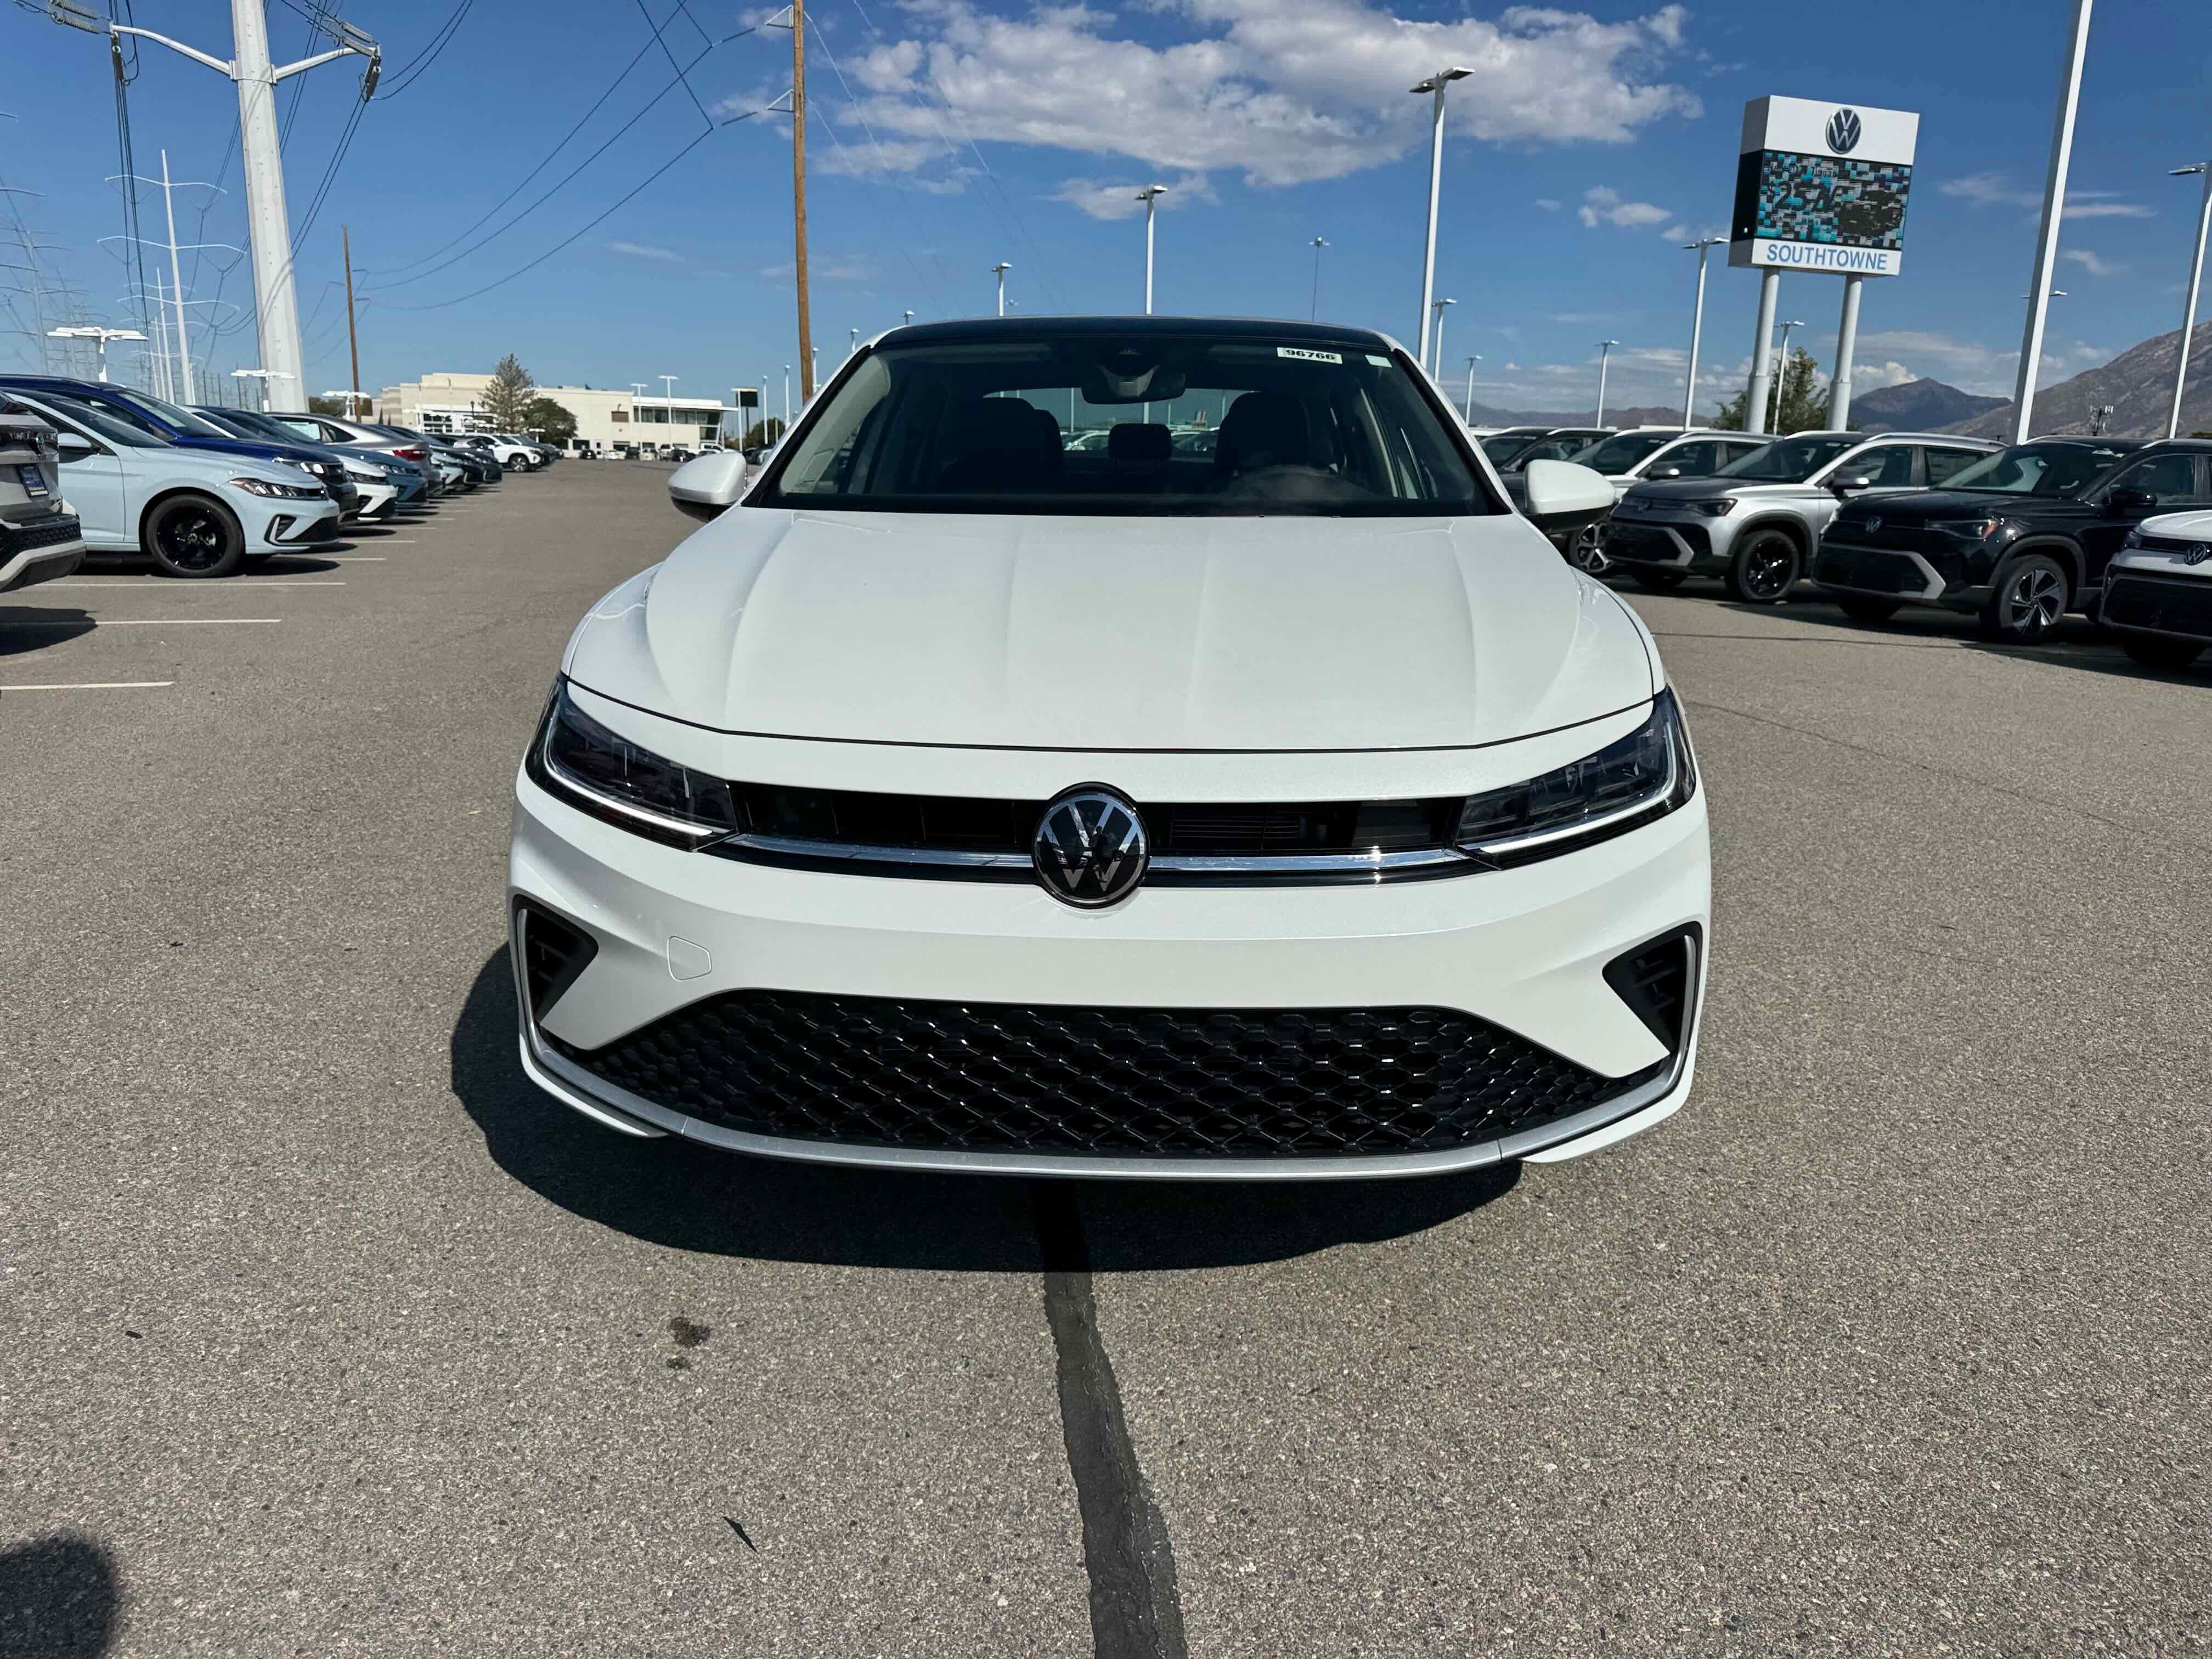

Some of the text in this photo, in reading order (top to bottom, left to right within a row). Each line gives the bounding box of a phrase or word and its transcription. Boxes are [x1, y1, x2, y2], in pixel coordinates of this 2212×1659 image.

[1826, 108, 1861, 152] VW
[1767, 244, 1888, 270] SOUTHTOWNE
[1285, 349, 1335, 360] 96766
[1034, 790, 1148, 902] VW
